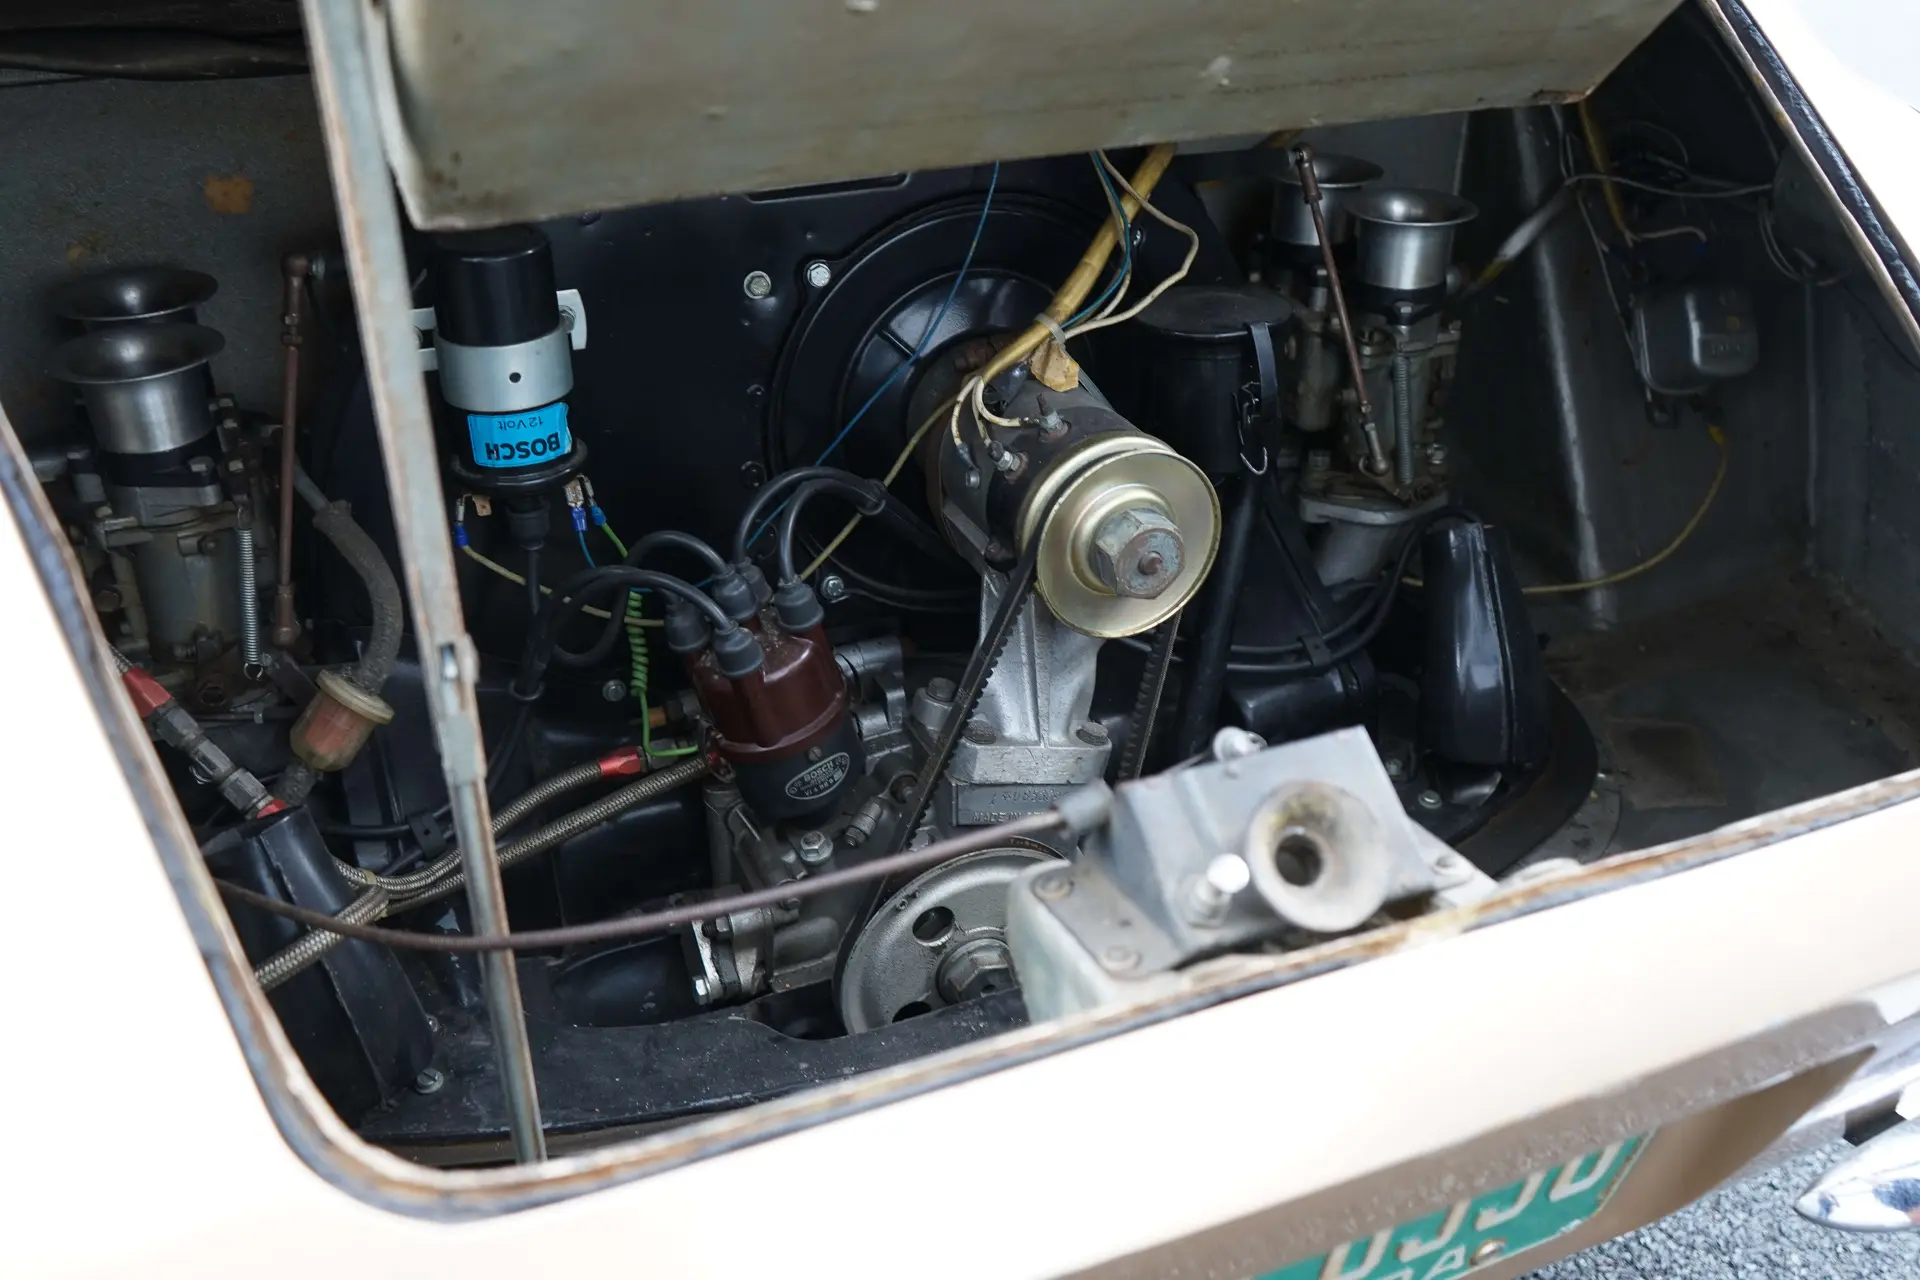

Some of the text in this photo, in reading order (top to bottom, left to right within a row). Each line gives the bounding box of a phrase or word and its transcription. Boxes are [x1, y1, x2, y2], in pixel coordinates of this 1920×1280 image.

[498, 416, 543, 431] 12 Volt
[485, 432, 560, 460] BOSCH
[804, 761, 834, 782] BOSCH
